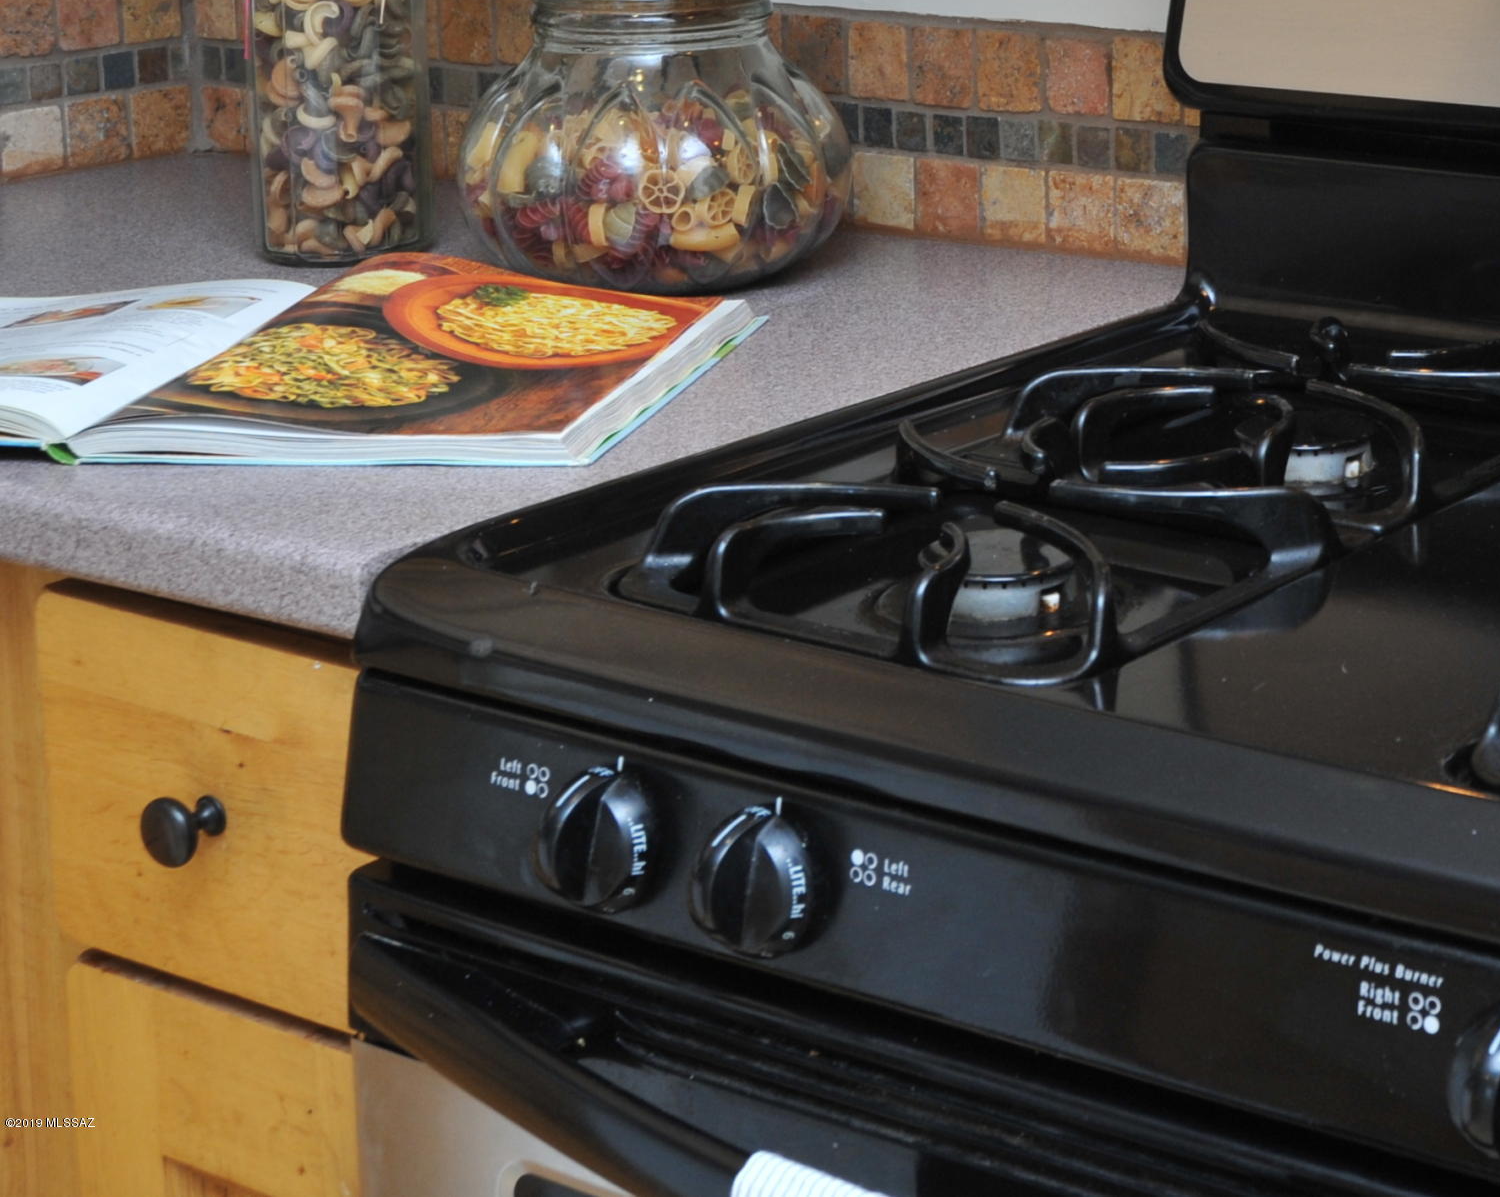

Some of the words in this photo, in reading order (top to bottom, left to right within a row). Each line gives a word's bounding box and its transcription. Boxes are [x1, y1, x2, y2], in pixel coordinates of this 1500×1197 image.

[500, 757, 522, 774] Left
[490, 771, 520, 791] Front
[884, 858, 909, 878] Left
[882, 875, 912, 896] Rear
[1314, 943, 1356, 966] Power
[1360, 955, 1390, 976] Plus
[1395, 963, 1444, 988] Burner
[1359, 981, 1400, 1006] Right
[1357, 999, 1398, 1025] Front
